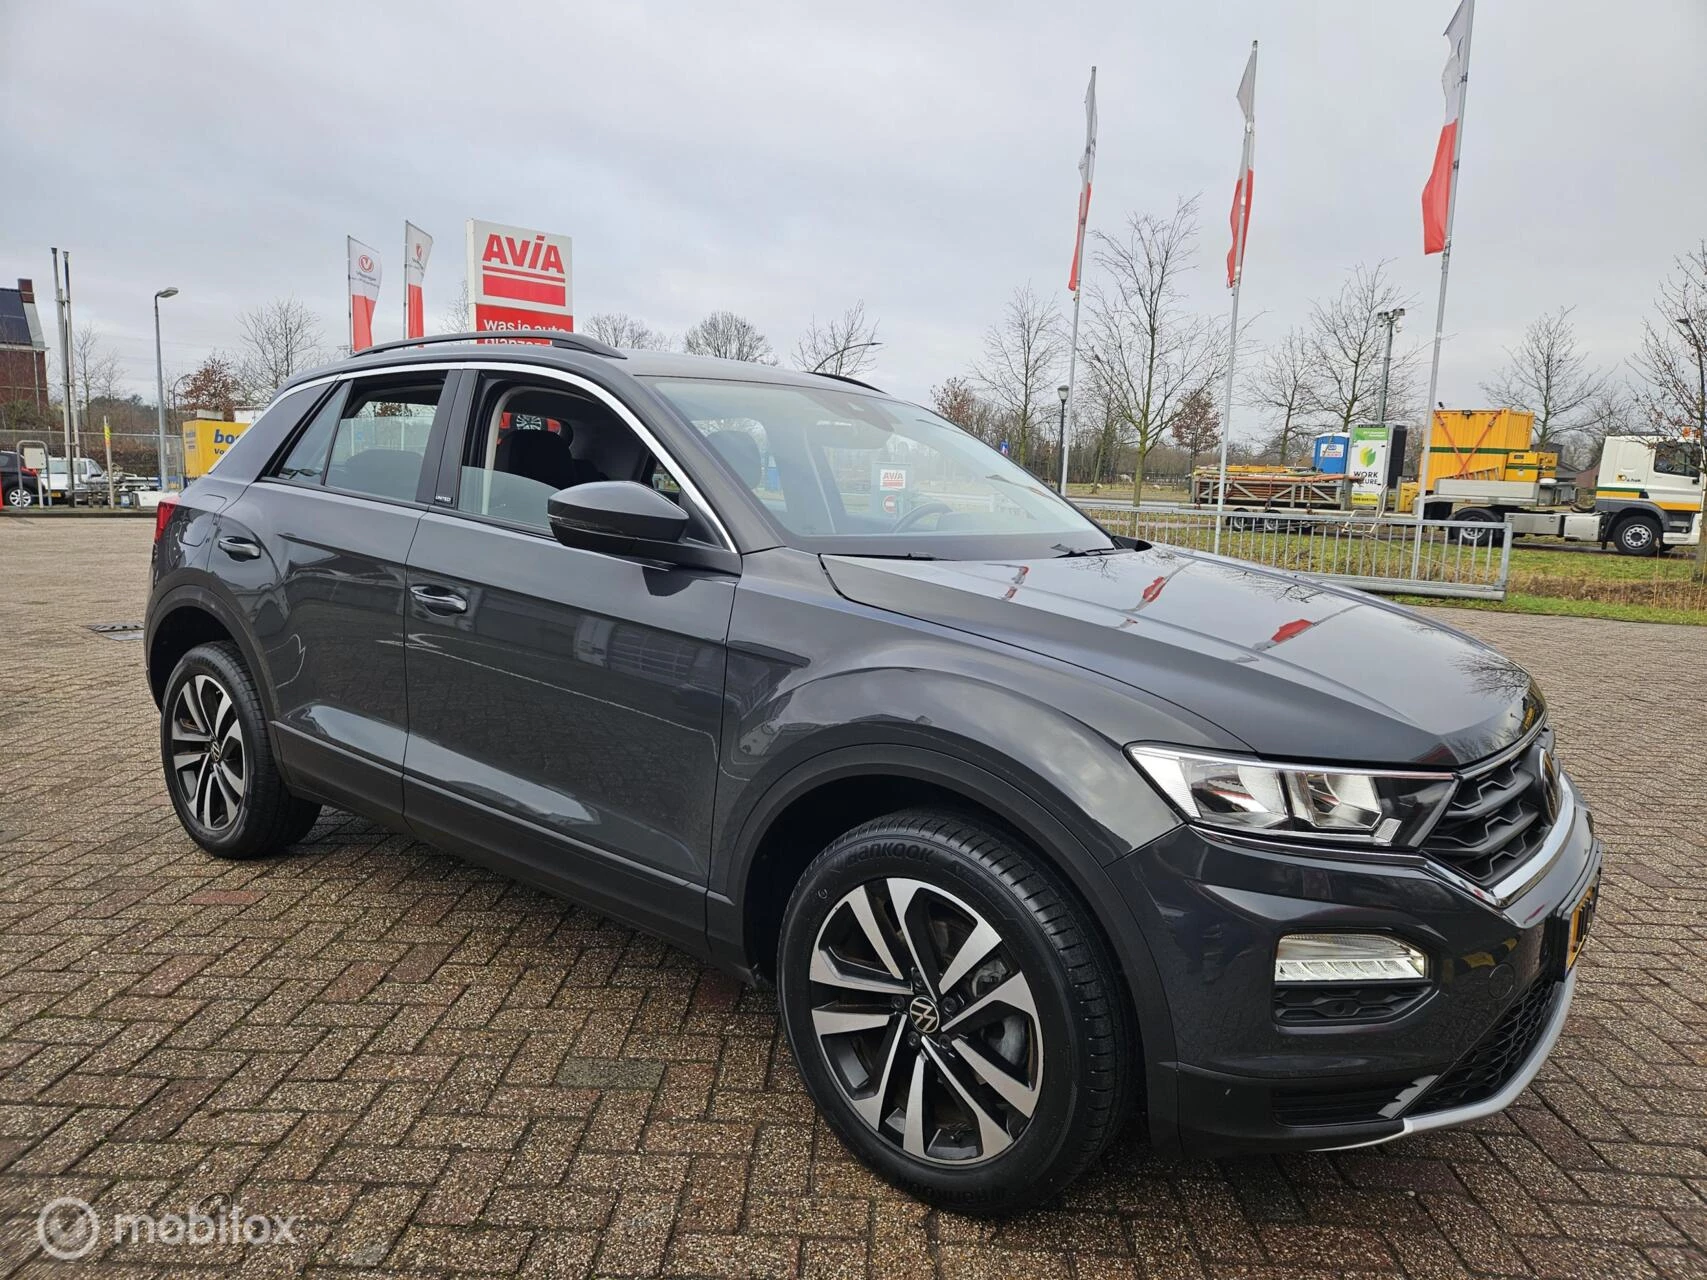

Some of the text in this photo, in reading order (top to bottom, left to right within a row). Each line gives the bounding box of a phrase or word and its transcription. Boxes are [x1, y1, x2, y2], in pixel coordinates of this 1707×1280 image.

[482, 233, 565, 274] AVIA
[484, 319, 515, 332] was
[214, 429, 239, 444] bo
[882, 471, 904, 480] AVIA
